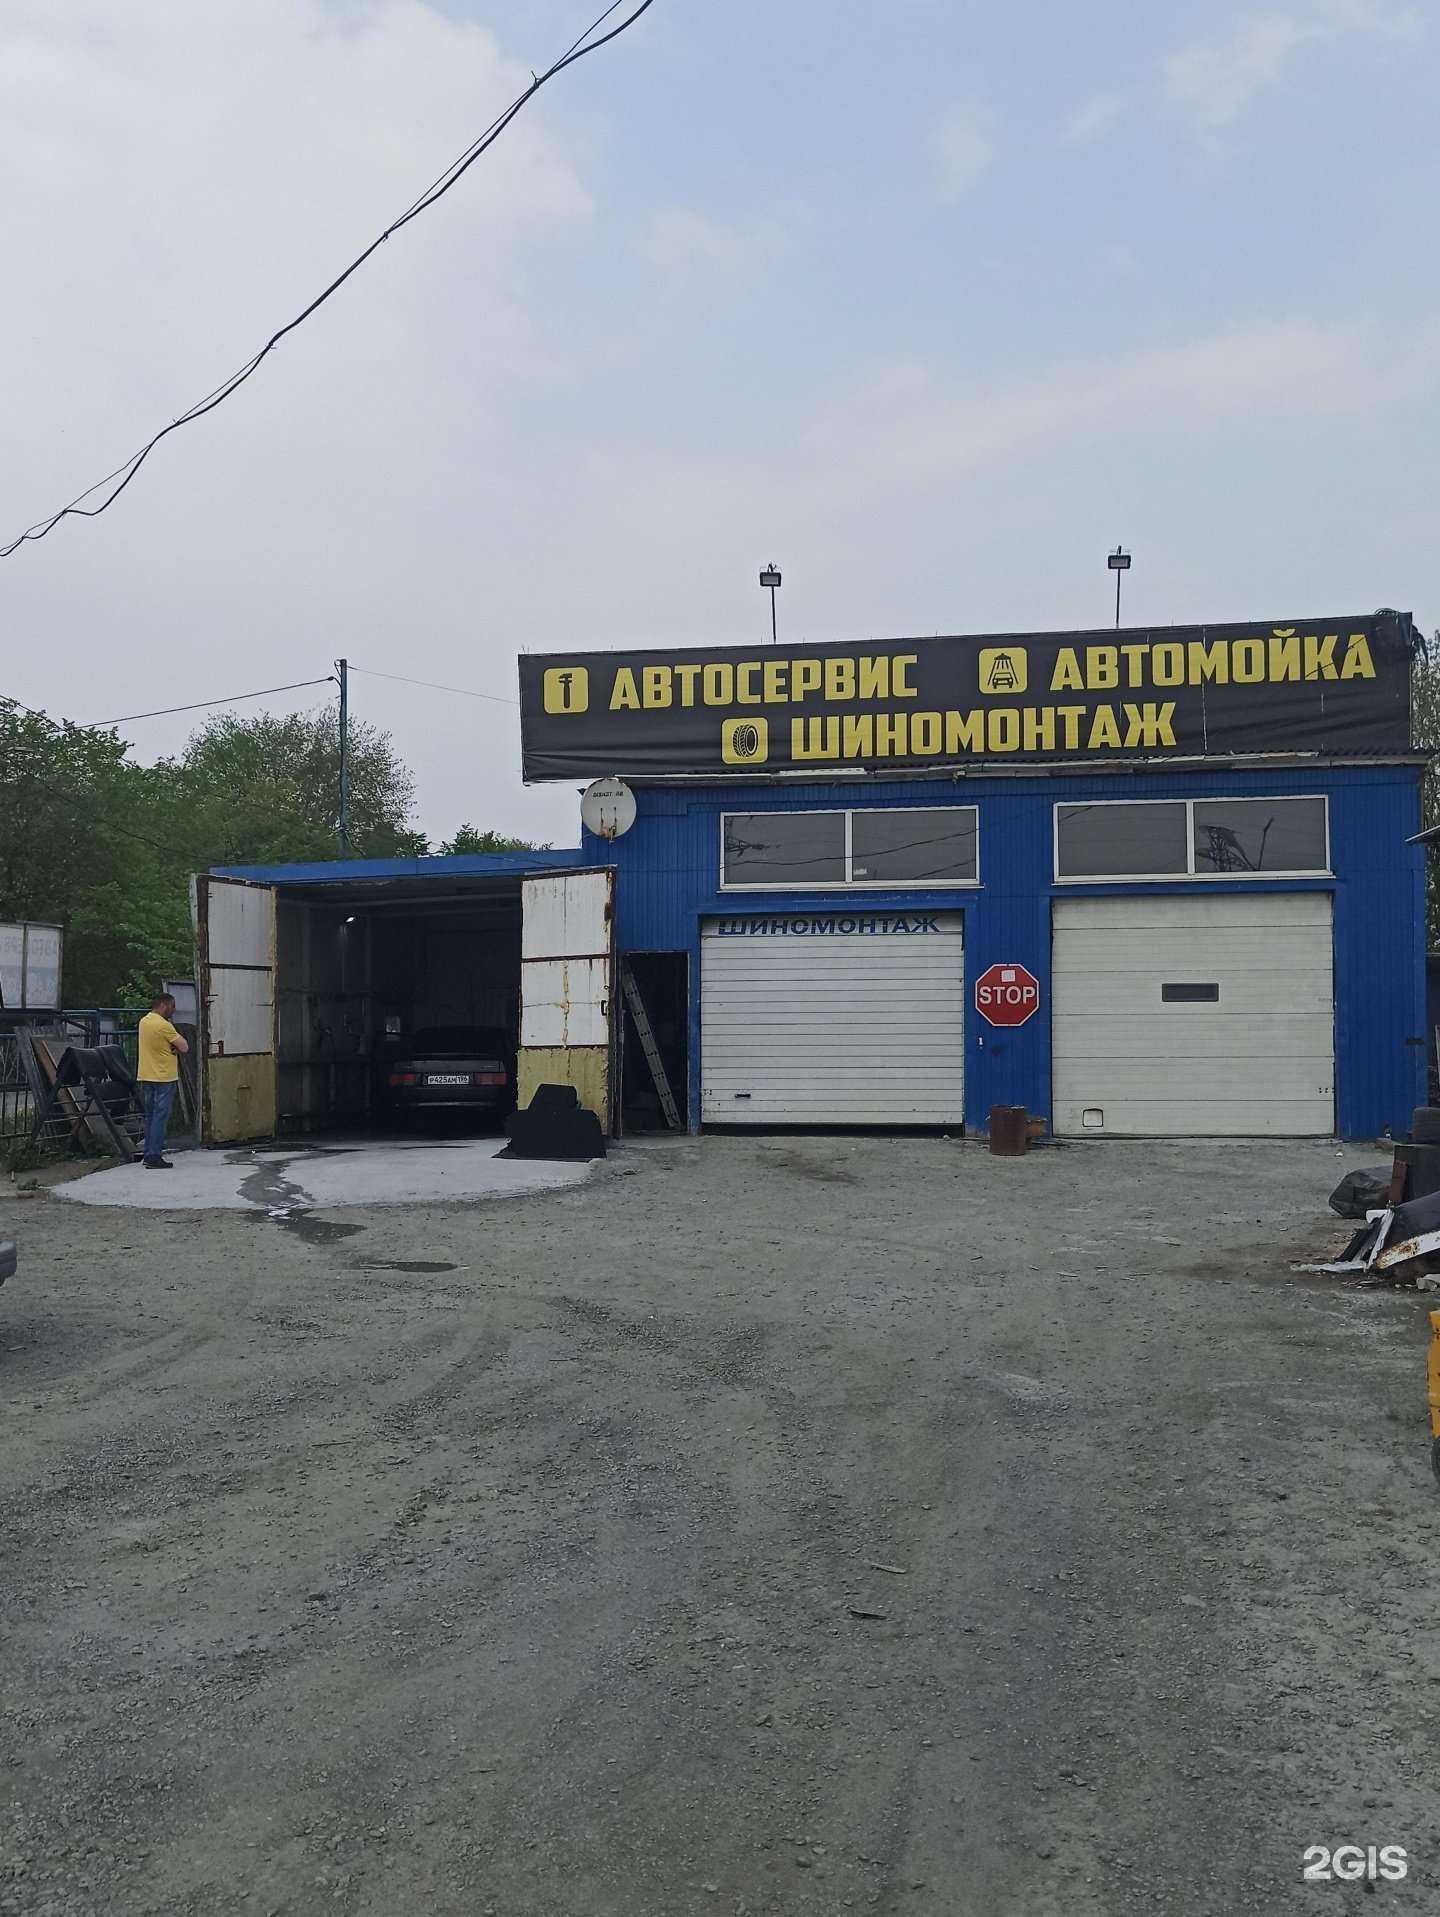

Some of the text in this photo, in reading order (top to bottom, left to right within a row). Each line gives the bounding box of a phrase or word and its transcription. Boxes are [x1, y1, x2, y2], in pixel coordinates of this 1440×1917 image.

[609, 655, 917, 710] АВТОСЕРВИС
[1050, 628, 1376, 691] АВТОМОЙКА
[791, 702, 1177, 760] ШИНОМОНТАЖ
[718, 917, 940, 935] ШИНОМОНТАЖ
[979, 986, 1036, 1004] STOP
